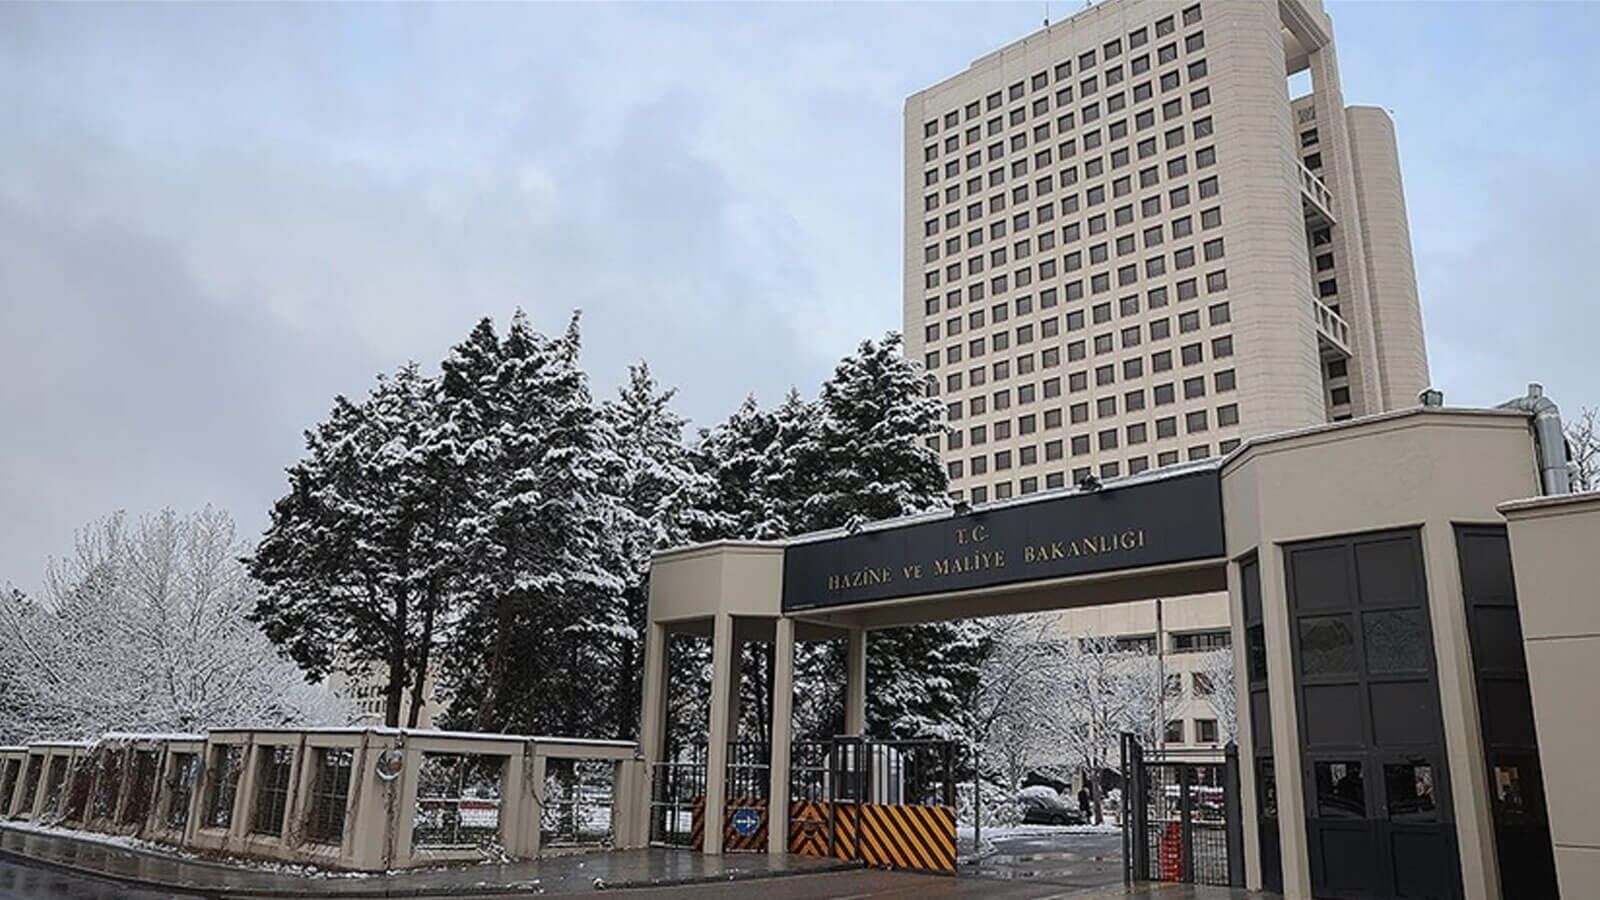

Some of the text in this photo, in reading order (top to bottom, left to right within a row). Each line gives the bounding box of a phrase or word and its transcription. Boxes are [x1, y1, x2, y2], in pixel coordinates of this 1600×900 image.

[828, 566, 892, 591] HAZİNE
[903, 563, 923, 579] VE
[935, 550, 1005, 576] MALİYE
